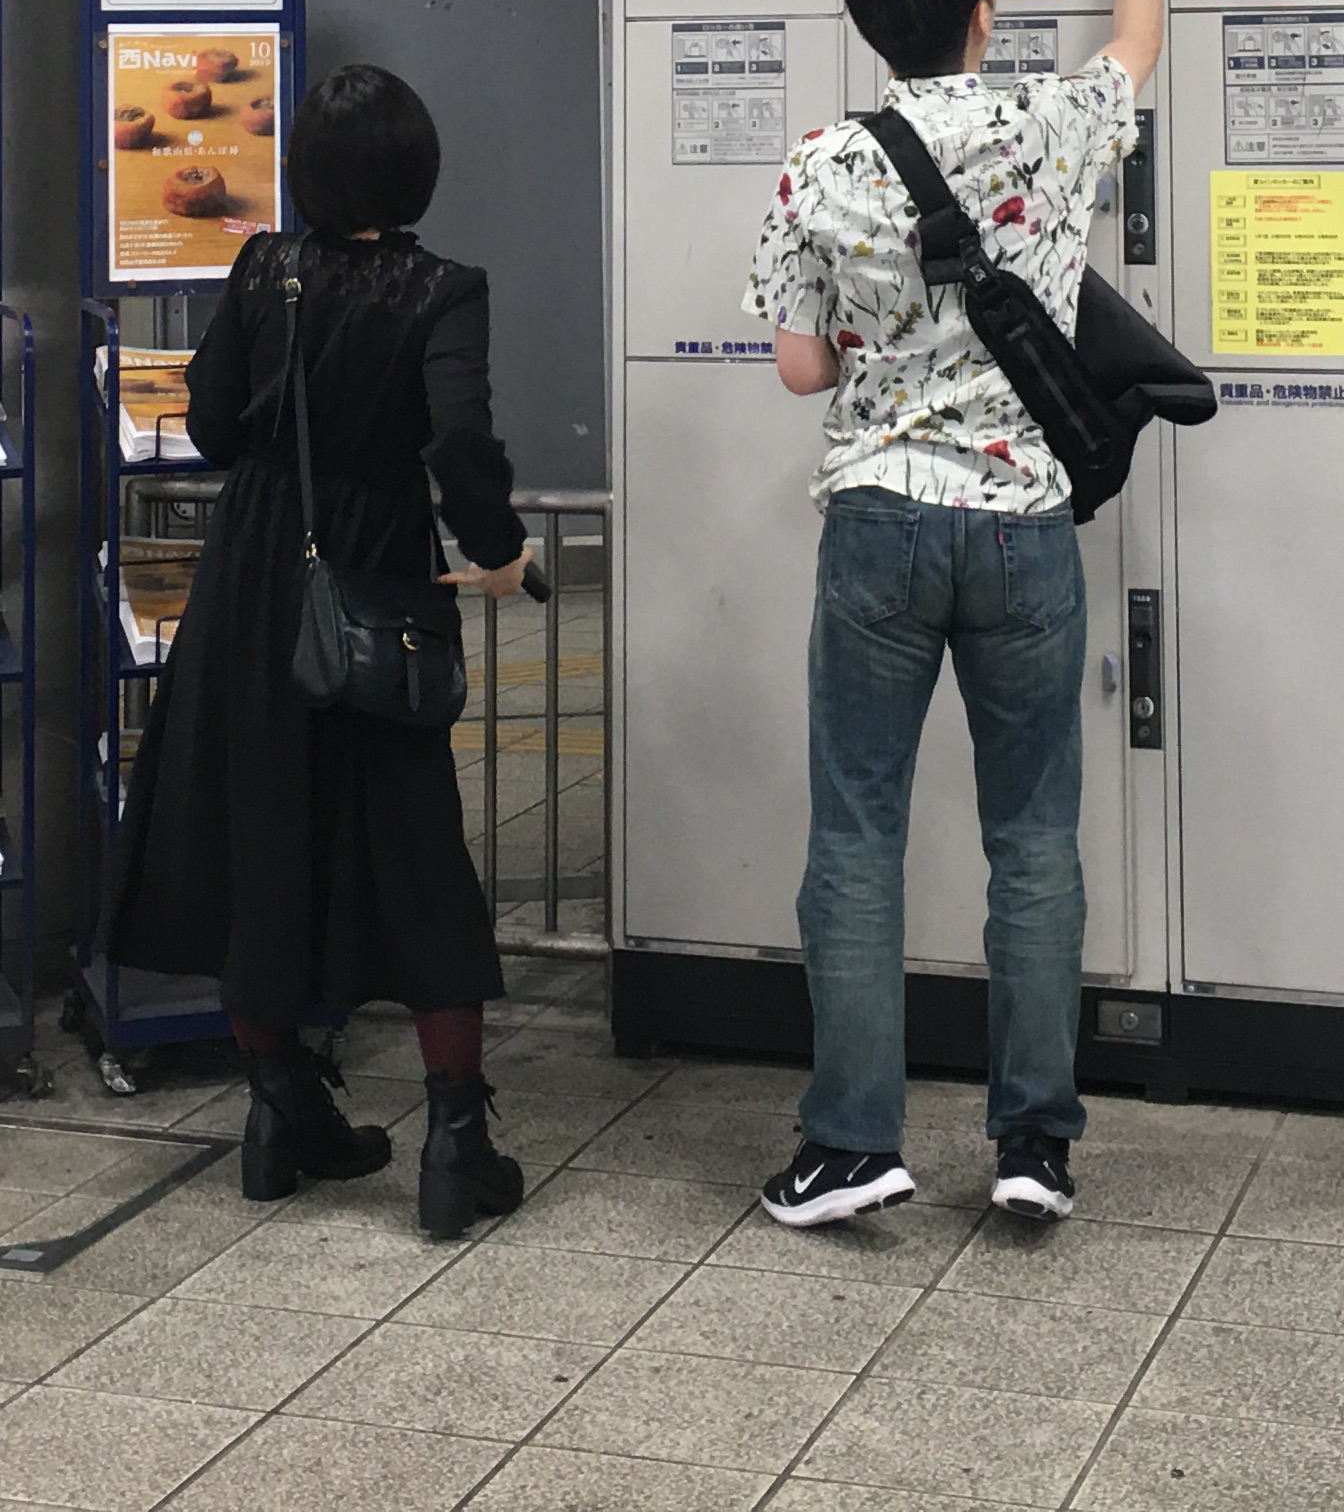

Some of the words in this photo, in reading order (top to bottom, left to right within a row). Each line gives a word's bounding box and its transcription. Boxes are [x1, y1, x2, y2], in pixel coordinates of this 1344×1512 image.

[118, 48, 197, 69] 西Navi
[249, 41, 271, 59] 10
[675, 341, 773, 354] 貴重品・危険物禁
